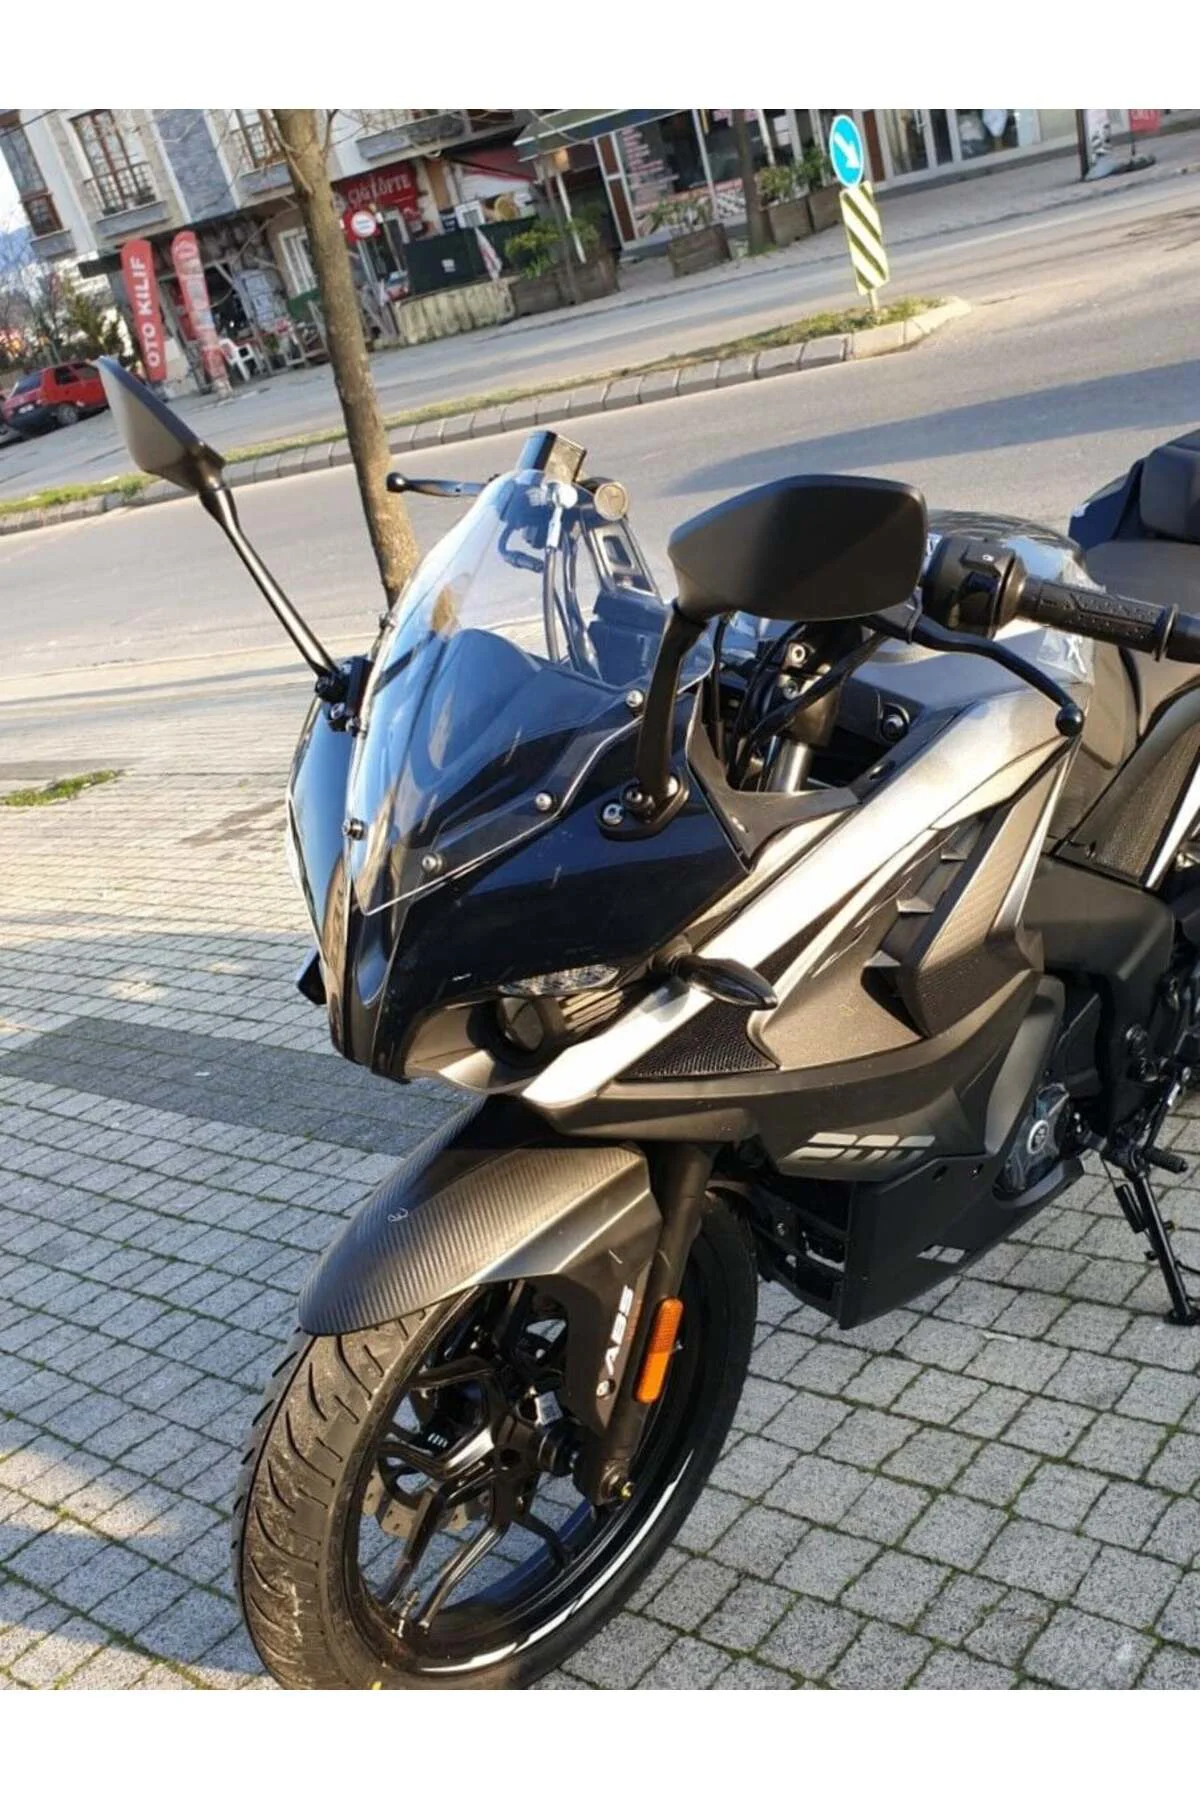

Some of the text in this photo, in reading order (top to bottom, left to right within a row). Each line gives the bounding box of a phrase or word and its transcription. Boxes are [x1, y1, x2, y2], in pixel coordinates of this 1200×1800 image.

[129, 256, 161, 368] OTO KILIF
[604, 1284, 634, 1377] ABS
